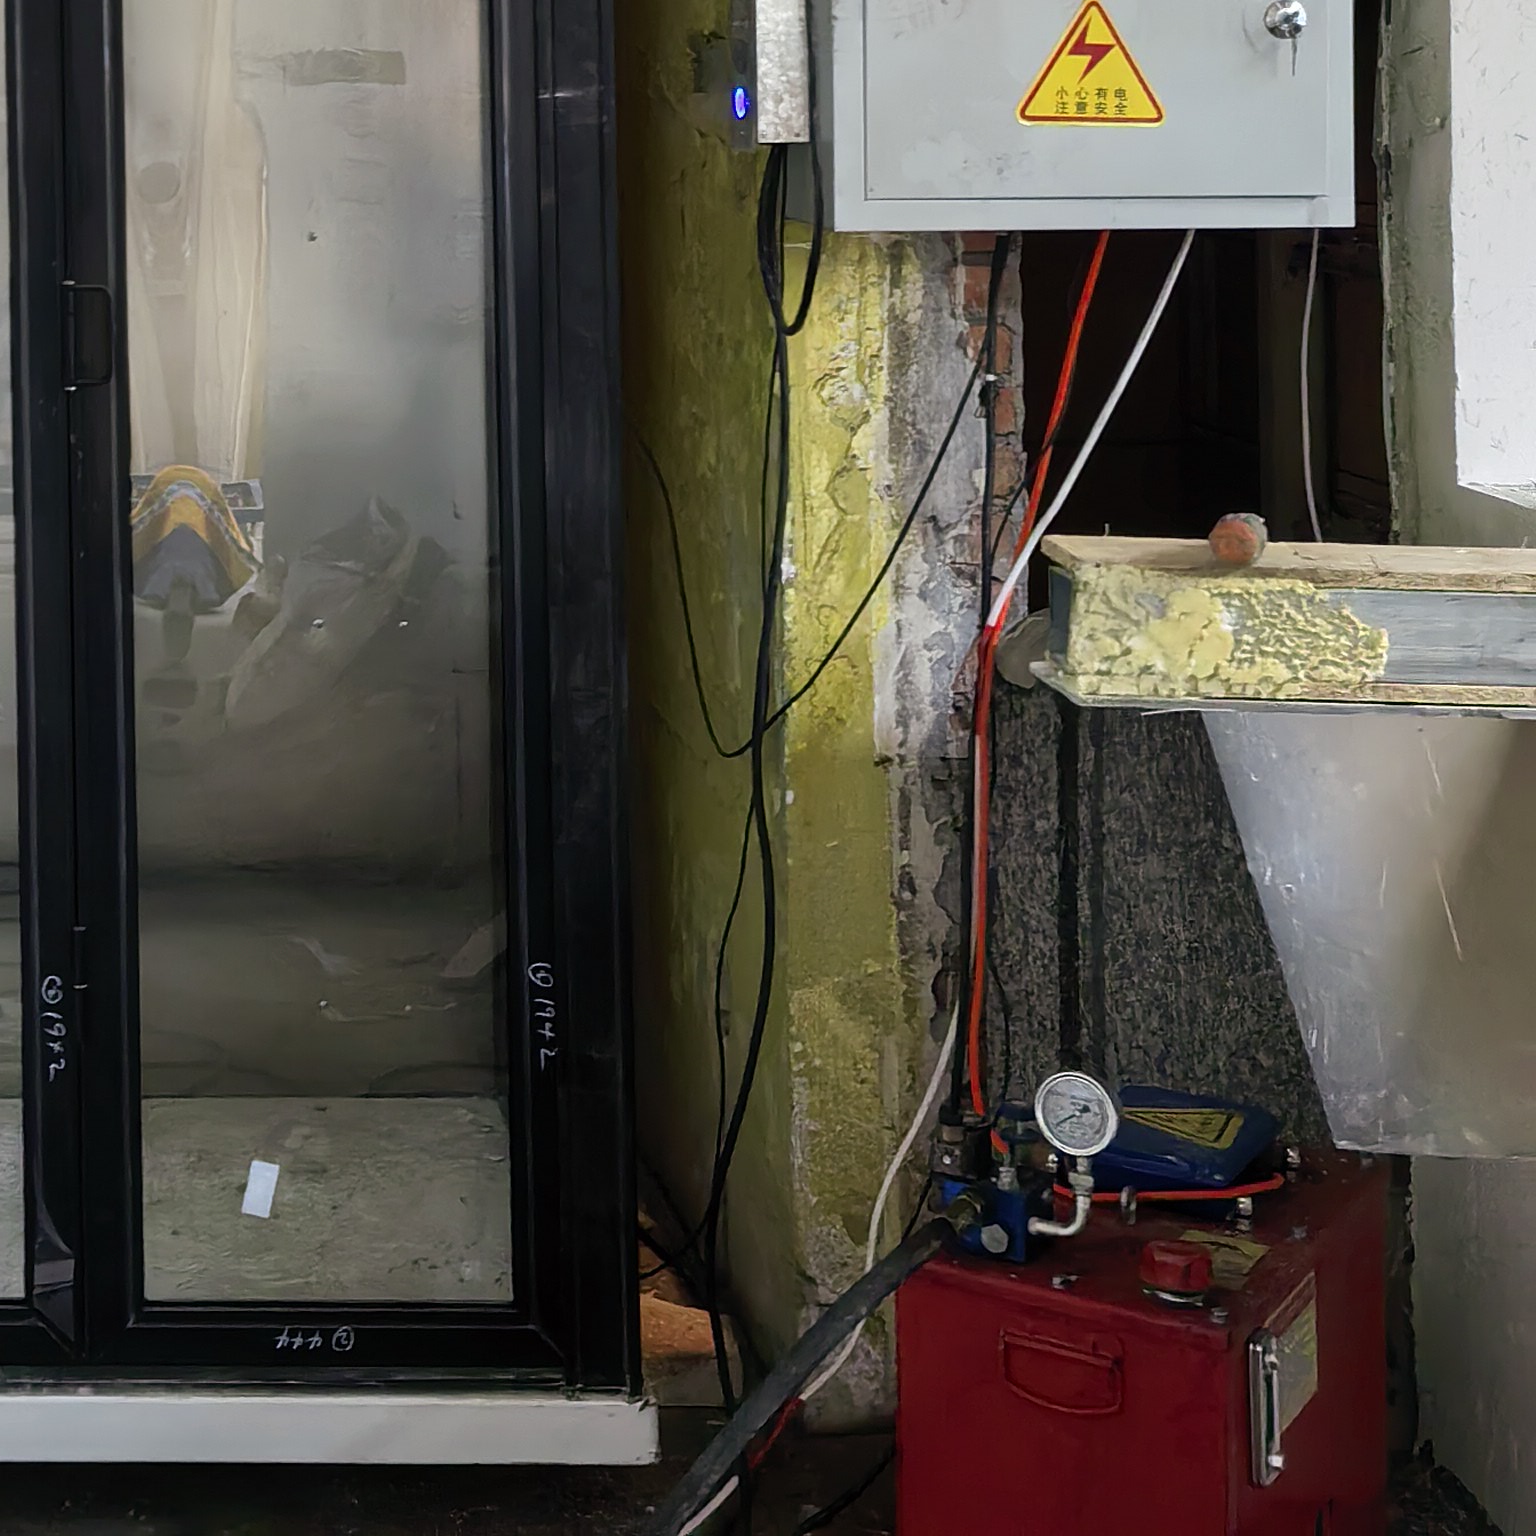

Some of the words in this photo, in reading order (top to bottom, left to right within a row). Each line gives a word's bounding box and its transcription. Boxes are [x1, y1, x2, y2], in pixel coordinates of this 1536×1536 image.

[1055, 85, 1128, 101] 小心有电
[1055, 101, 1128, 116] 注意安全
